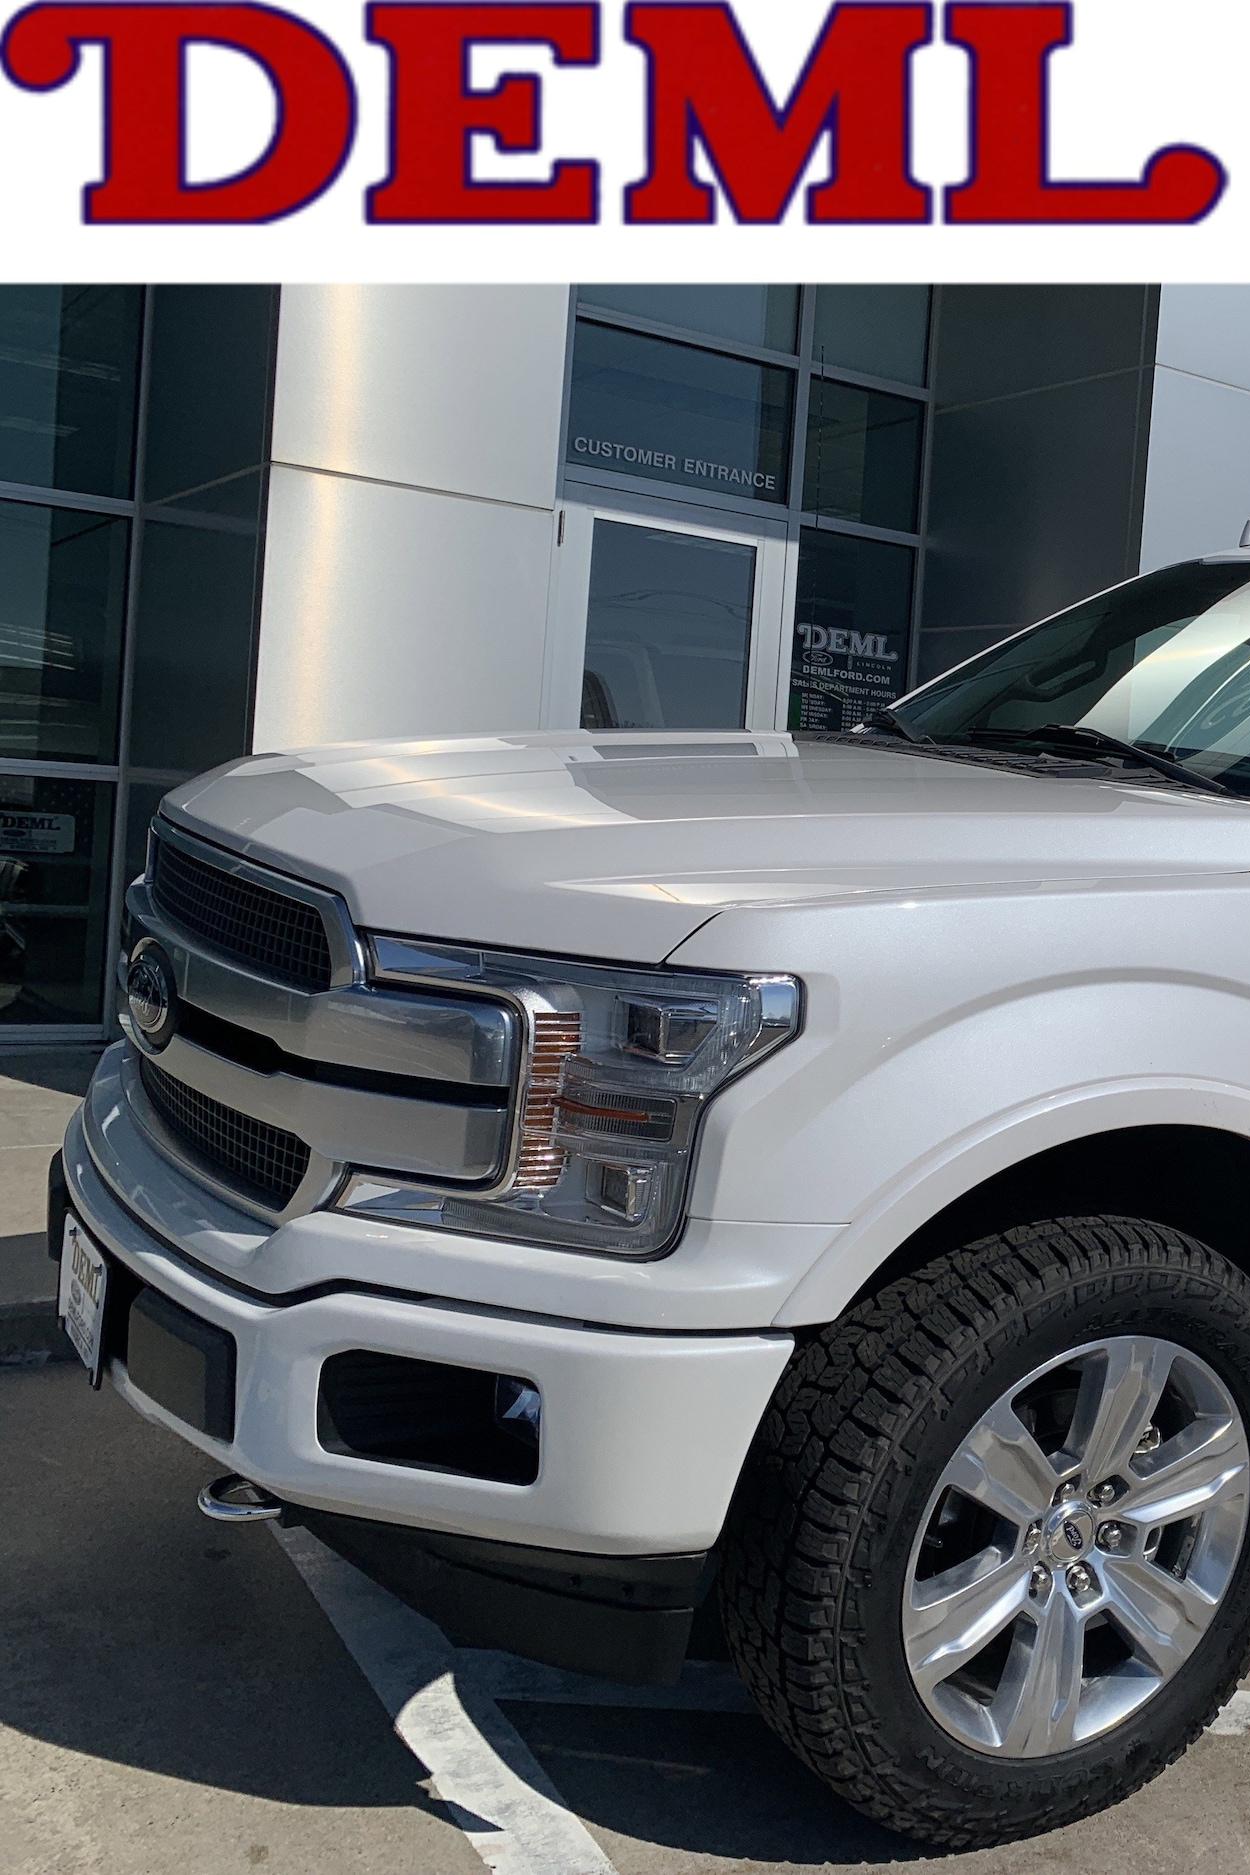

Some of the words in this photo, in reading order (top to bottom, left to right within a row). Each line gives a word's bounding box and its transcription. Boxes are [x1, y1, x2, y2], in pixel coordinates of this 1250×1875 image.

[574, 436, 676, 470] CUSTOMER
[683, 458, 776, 491] ENTRANCE
[797, 623, 898, 661] DEML
[803, 665, 890, 685] DEMLFORD.COM
[857, 662, 892, 671] LINCOLN
[819, 683, 870, 696] DEPARTMENT
[871, 690, 897, 699] HOURS
[0, 815, 61, 831] DEML
